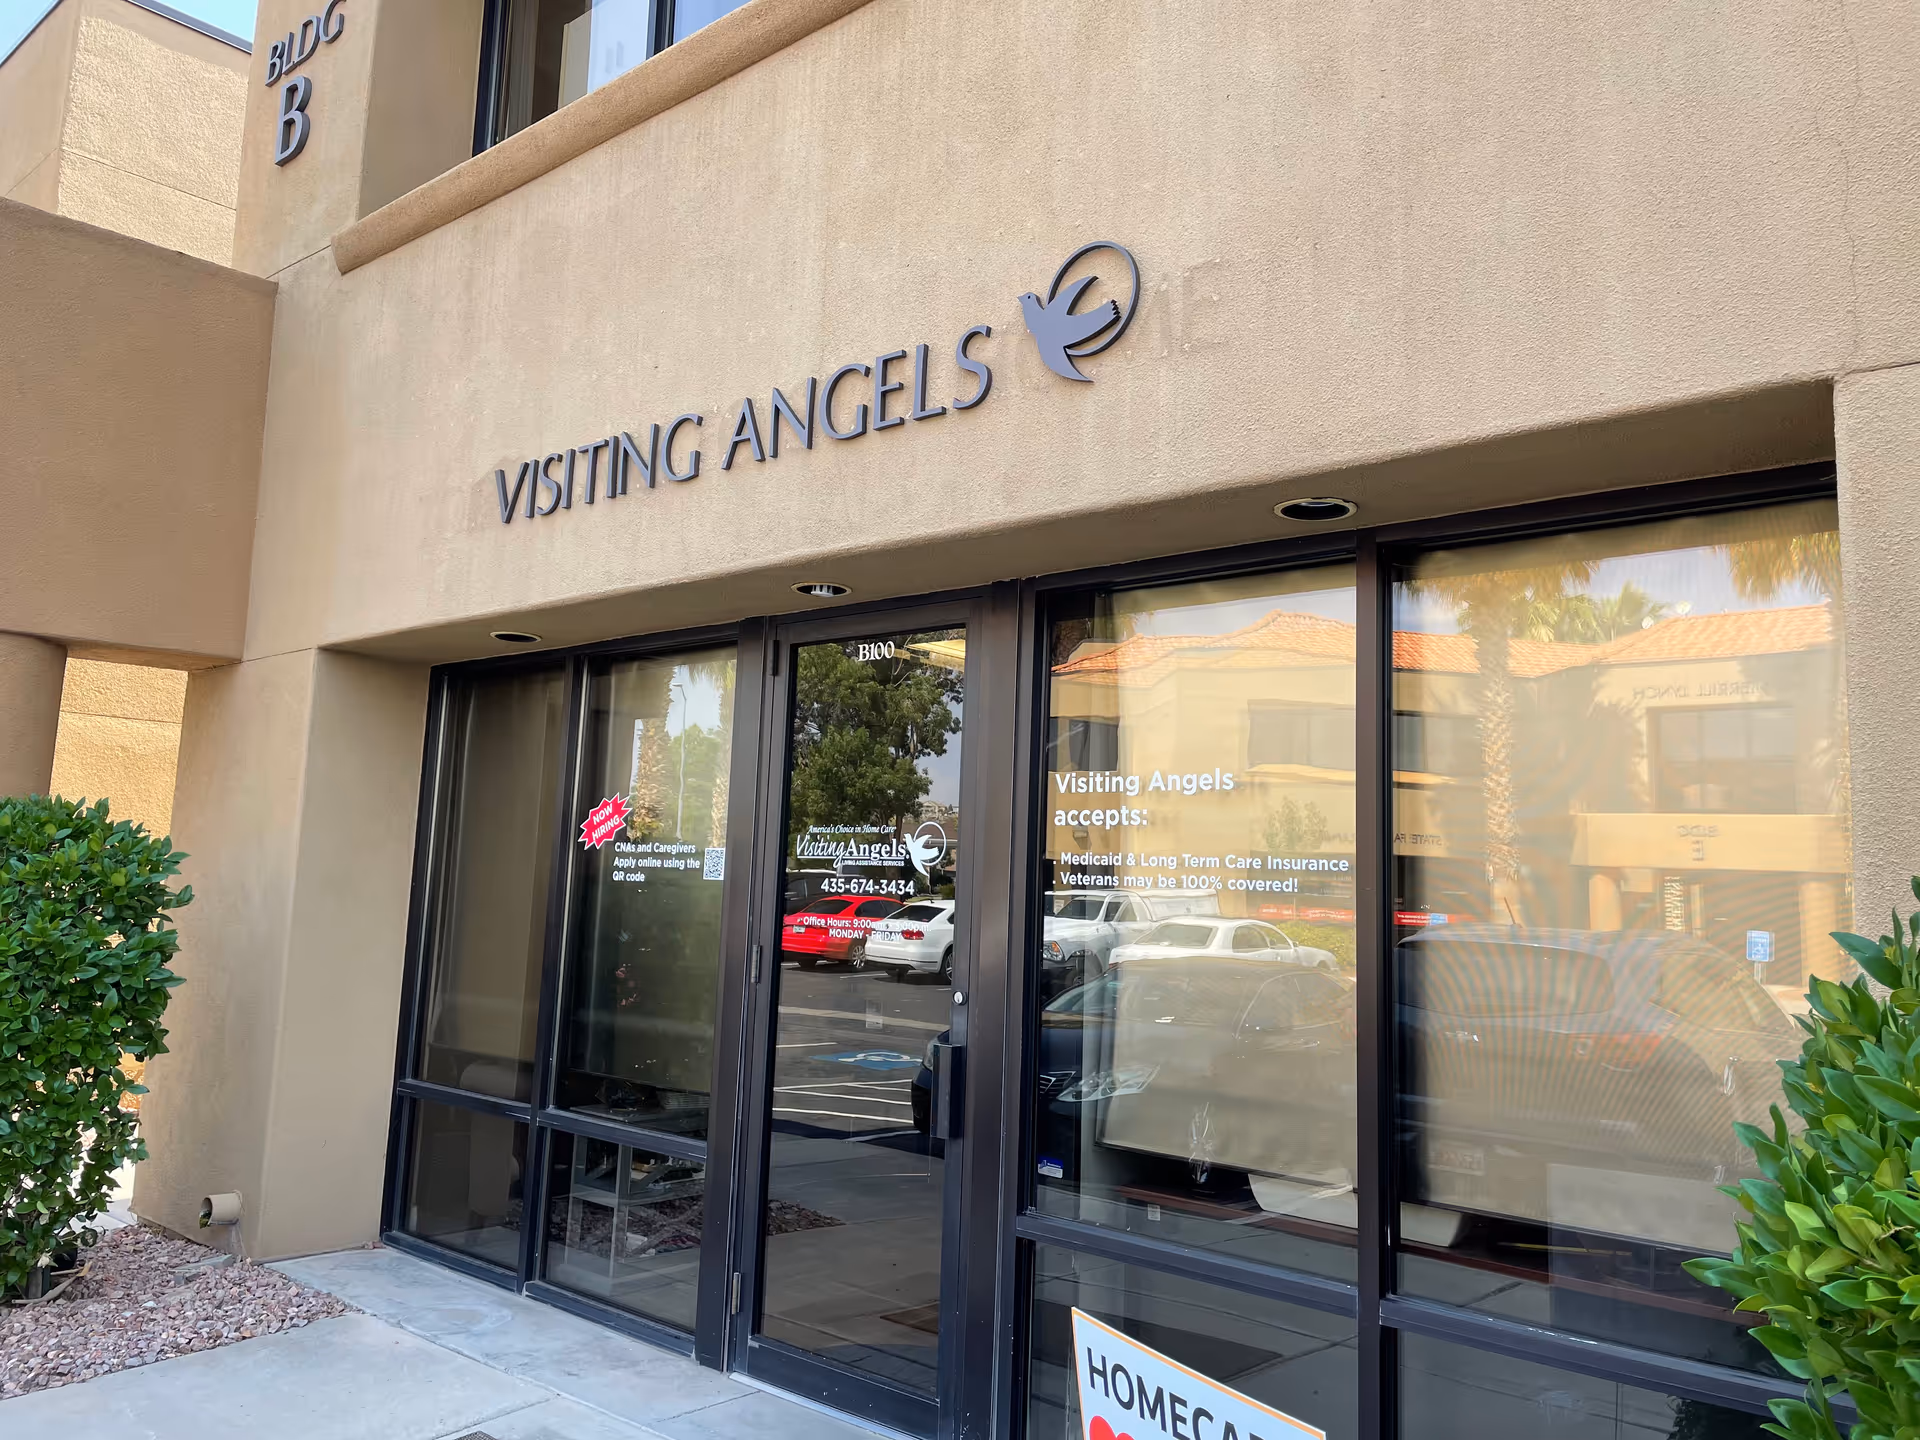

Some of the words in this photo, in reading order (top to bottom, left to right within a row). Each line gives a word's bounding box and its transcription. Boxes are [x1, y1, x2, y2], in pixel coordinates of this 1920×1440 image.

[265, 0, 346, 87] BLDG
[275, 75, 312, 167] B
[494, 414, 703, 524] VISITING
[721, 325, 993, 470] ANGELS
[857, 641, 895, 662] B100
[1055, 771, 1140, 796] Visiting
[1148, 768, 1234, 796] Angels
[592, 803, 613, 825] NOW
[1054, 805, 1148, 830] accepts:
[592, 814, 620, 841] HIRING
[835, 824, 854, 834] Choice
[615, 842, 635, 852] CNAs
[637, 842, 652, 852] and
[653, 842, 696, 854] Caregivers
[796, 834, 846, 868] Visiting
[613, 856, 636, 868] Apply
[637, 857, 662, 867] online
[663, 857, 685, 870] using
[687, 858, 700, 868] the
[1060, 851, 1122, 866] Medicaid
[1126, 853, 1136, 867] &
[1140, 853, 1177, 871] Long
[1182, 854, 1220, 869] Term
[1225, 855, 1262, 870] Care
[1267, 855, 1349, 872] Insurance
[612, 871, 625, 881] QR
[626, 871, 645, 882] code
[821, 878, 915, 895] 435-674-3434
[1060, 872, 1119, 887] Veterans
[1123, 875, 1154, 890] may
[1158, 873, 1176, 888] be
[1181, 875, 1223, 890] 100%
[1227, 877, 1298, 893] covered!
[803, 916, 826, 927] Office
[827, 917, 851, 928] Hours:
[829, 930, 864, 940] MONDAY
[871, 930, 901, 941] FRIDAY
[1087, 1346, 1264, 1440] HOMEC
